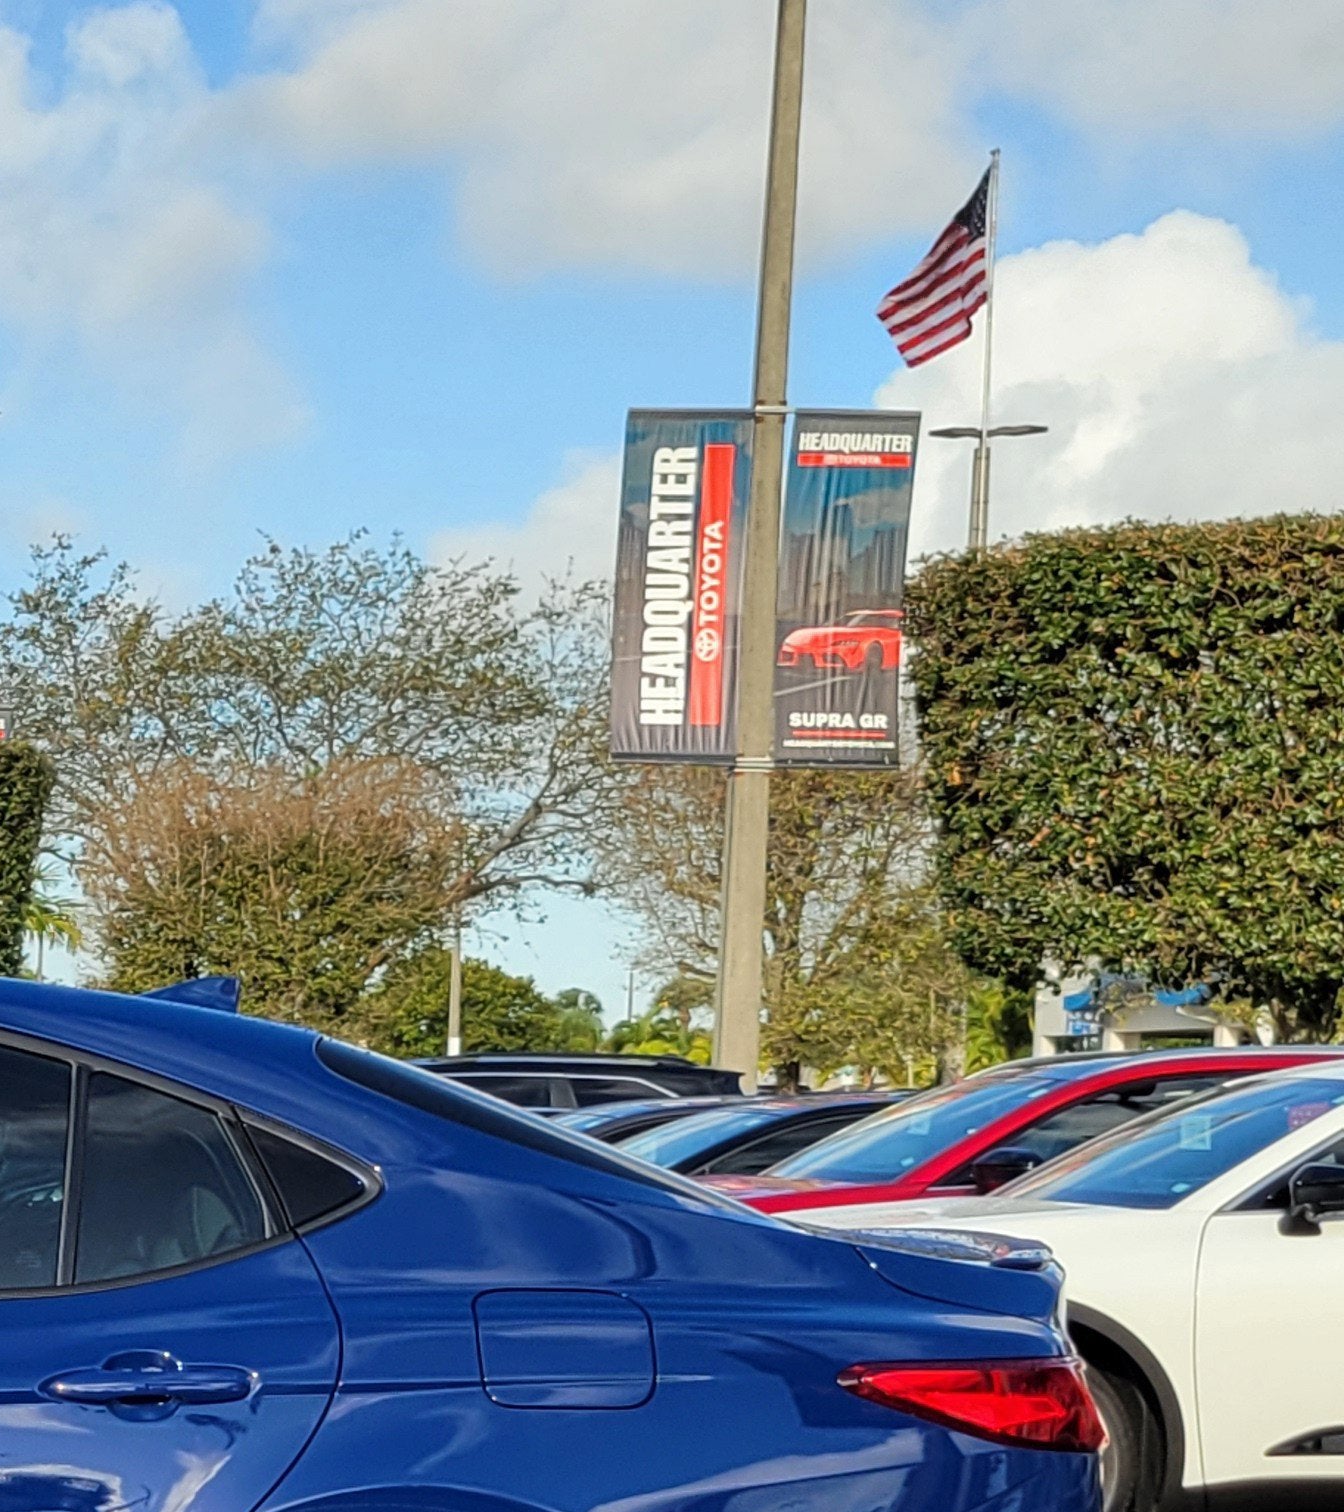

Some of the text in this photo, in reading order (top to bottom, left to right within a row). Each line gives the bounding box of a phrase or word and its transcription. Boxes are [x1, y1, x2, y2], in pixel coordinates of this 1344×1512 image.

[799, 432, 912, 454] HEADQUARTER
[639, 446, 698, 725] HEADQUARTER
[699, 520, 725, 626] TOYOTA
[789, 712, 888, 729] SUPRA GR
